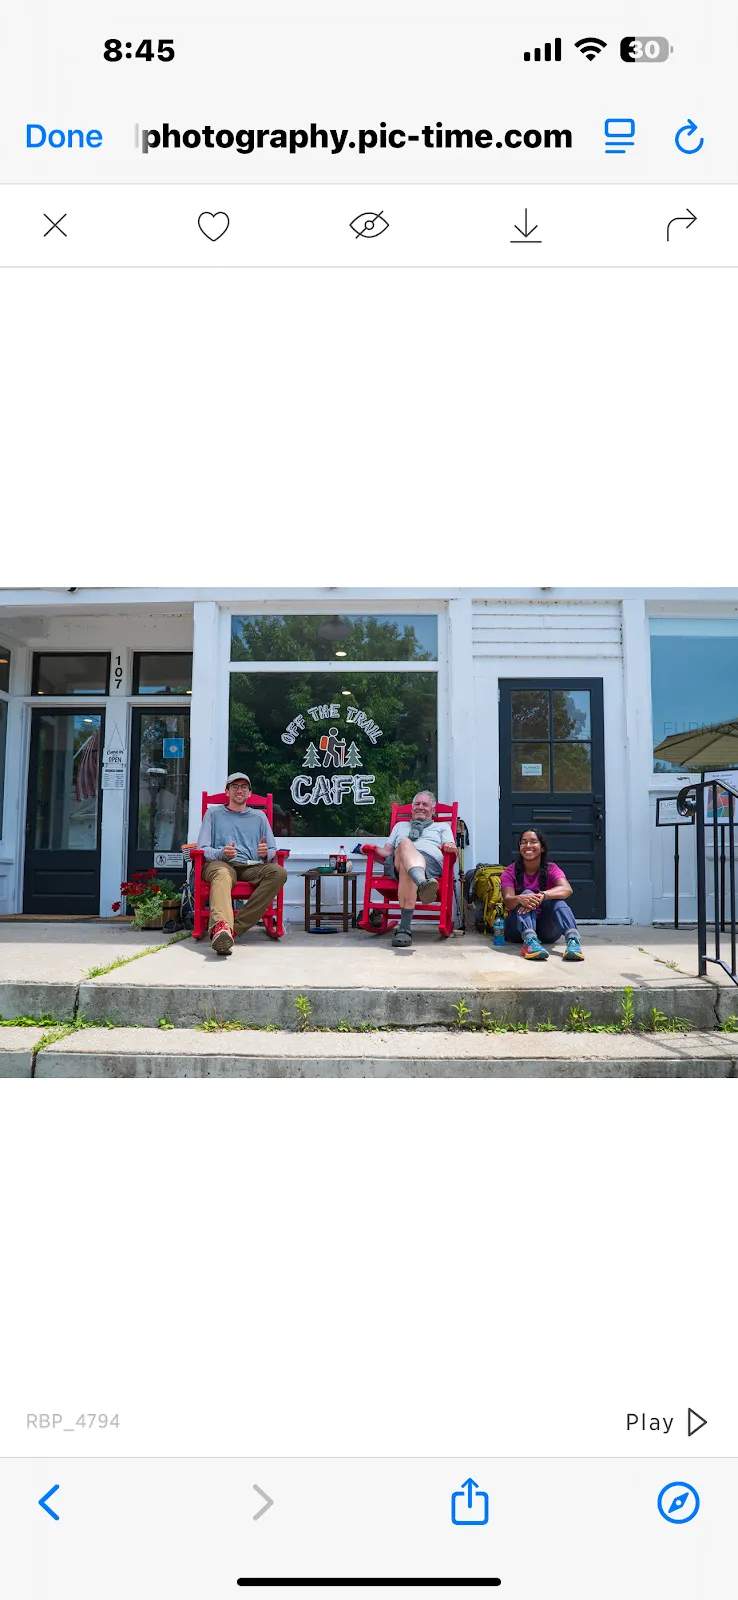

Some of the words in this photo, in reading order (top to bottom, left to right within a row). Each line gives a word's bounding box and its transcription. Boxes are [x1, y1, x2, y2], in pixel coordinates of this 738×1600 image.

[114, 655, 123, 689] 107
[281, 714, 306, 745] OFF
[307, 703, 341, 722] THE
[346, 706, 384, 745] TRAIL
[290, 774, 375, 805] CAFE
